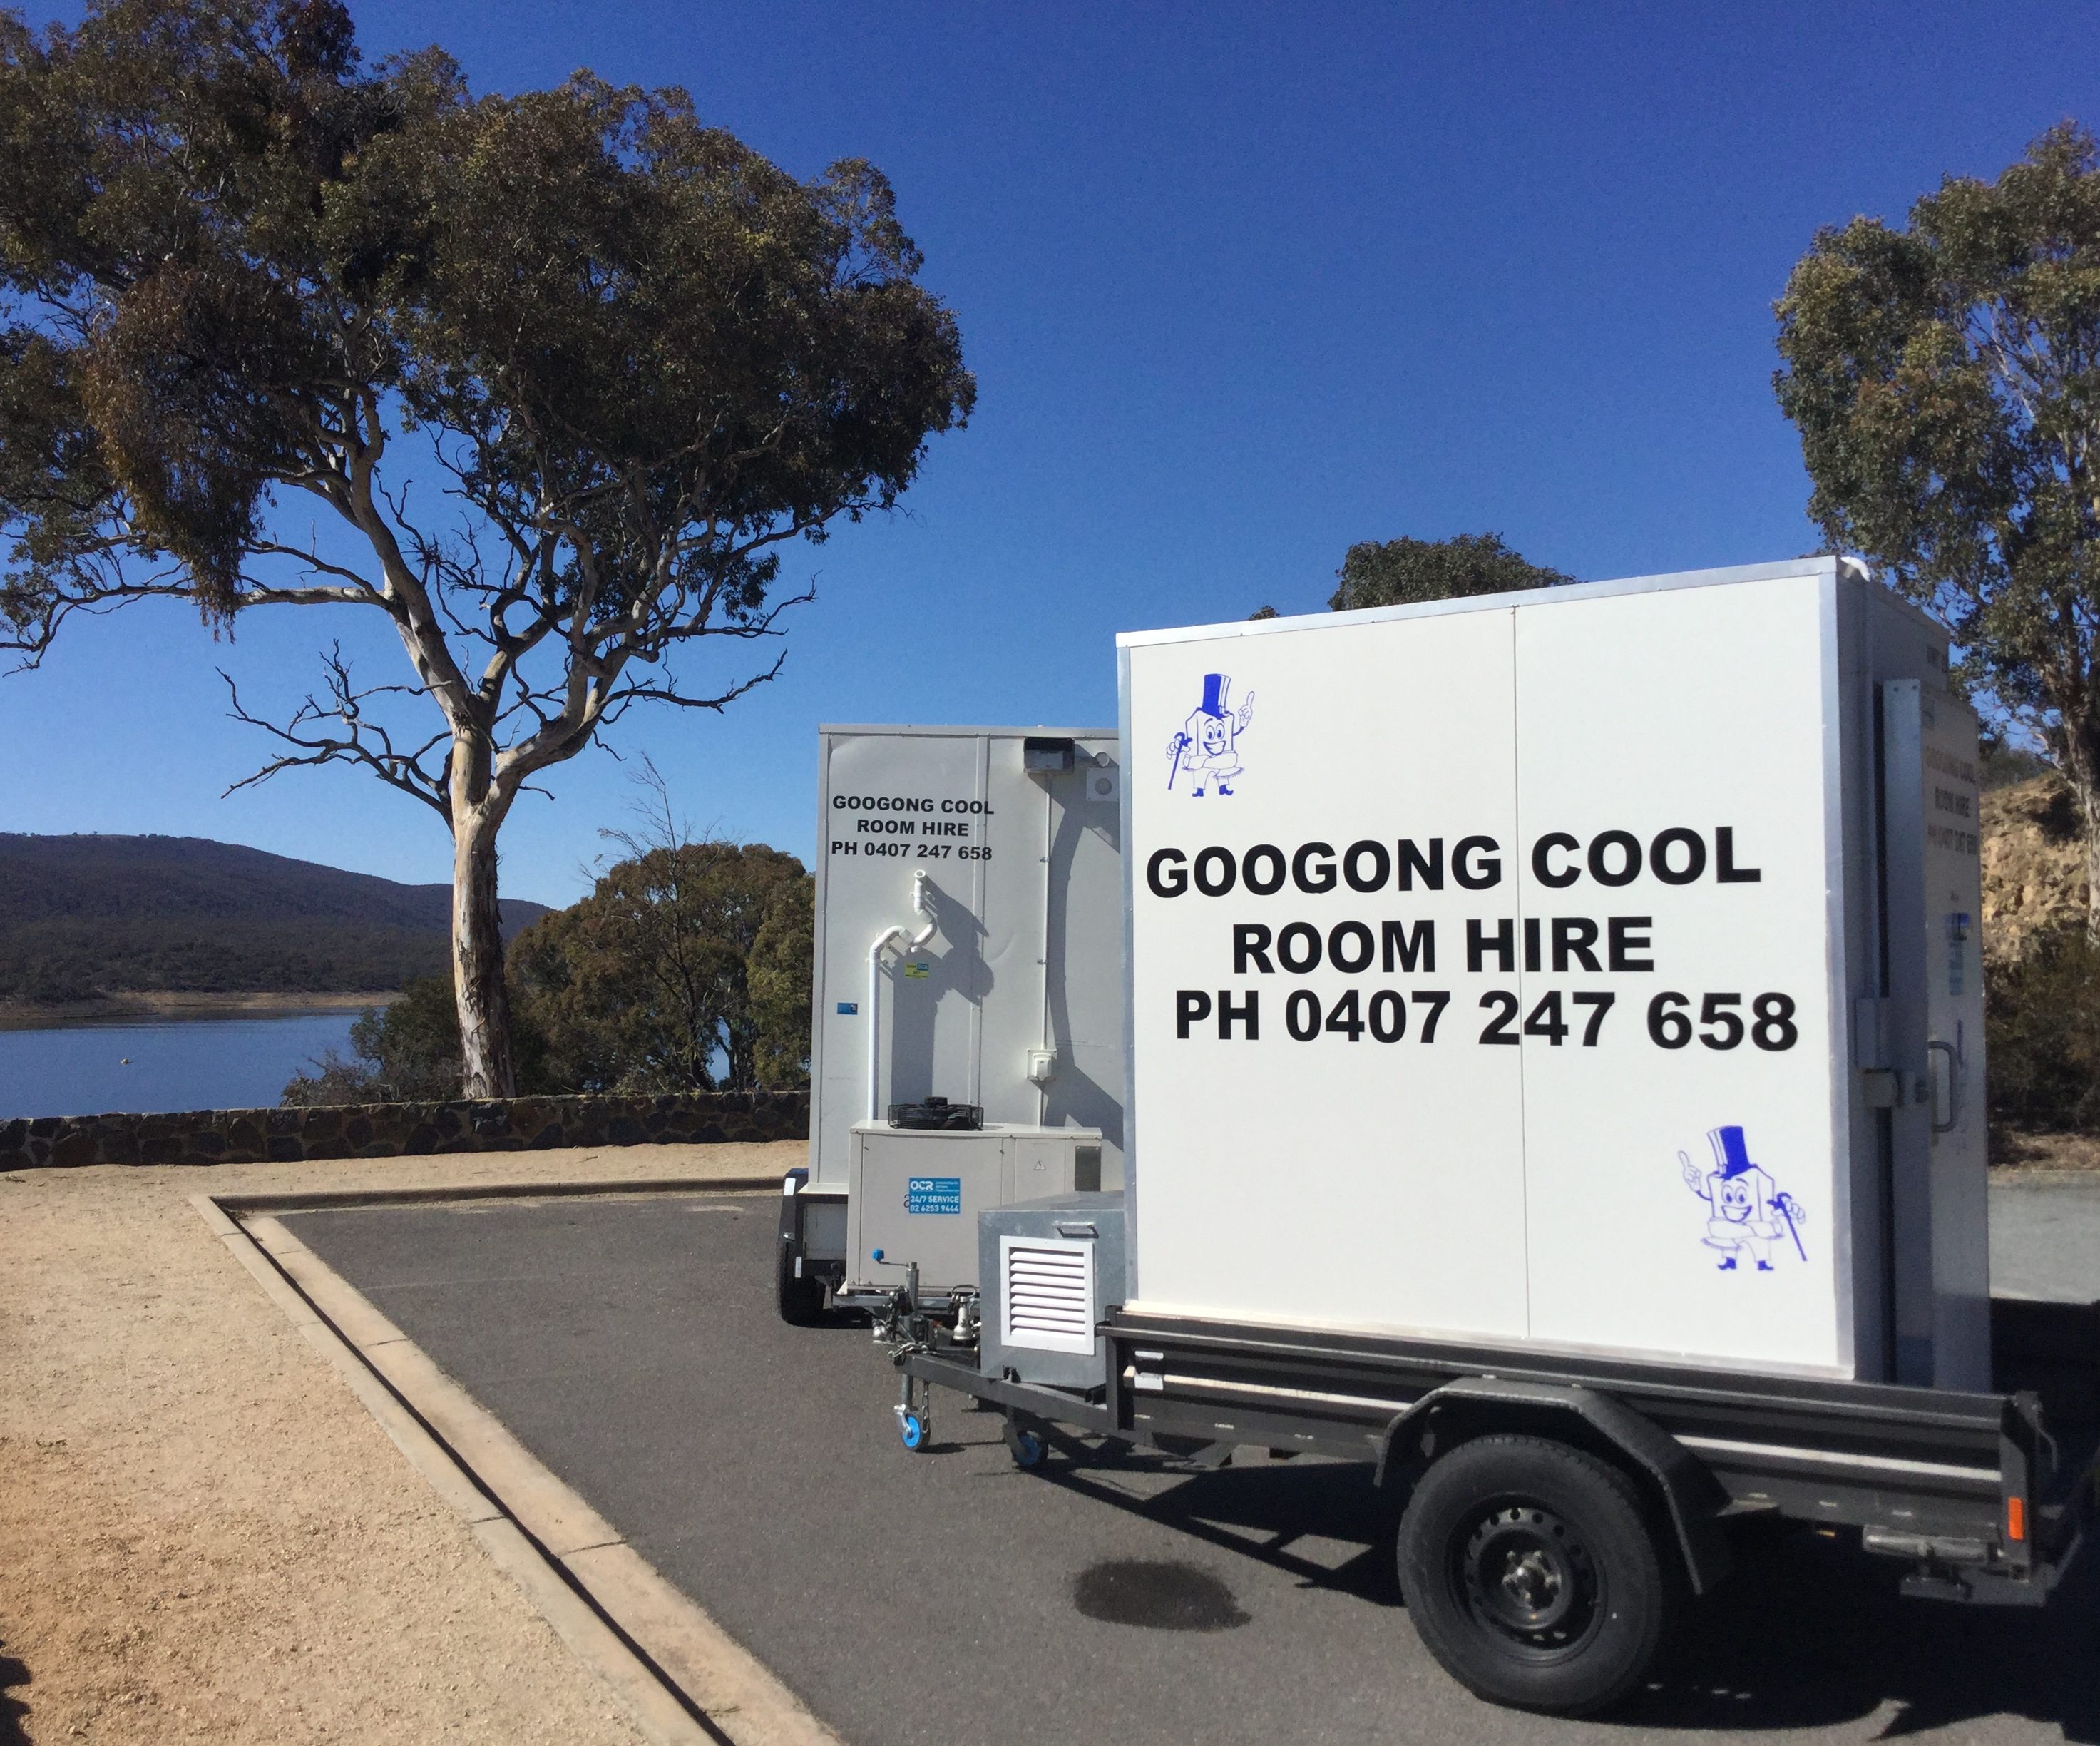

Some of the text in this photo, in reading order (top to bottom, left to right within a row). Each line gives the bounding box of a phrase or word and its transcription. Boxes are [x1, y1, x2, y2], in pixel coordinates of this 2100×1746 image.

[832, 795, 995, 815] GOOGONG COOL
[857, 819, 969, 837] ROOM HIRE
[831, 841, 993, 861] PH 0407 247 658
[1146, 826, 1762, 899] GOOGONG COOL
[1232, 916, 1655, 974] ROOM HIRE
[1175, 989, 1798, 1053] PH 0407 247 658
[910, 1180, 933, 1190] OCR
[910, 1195, 927, 1203] 24/7
